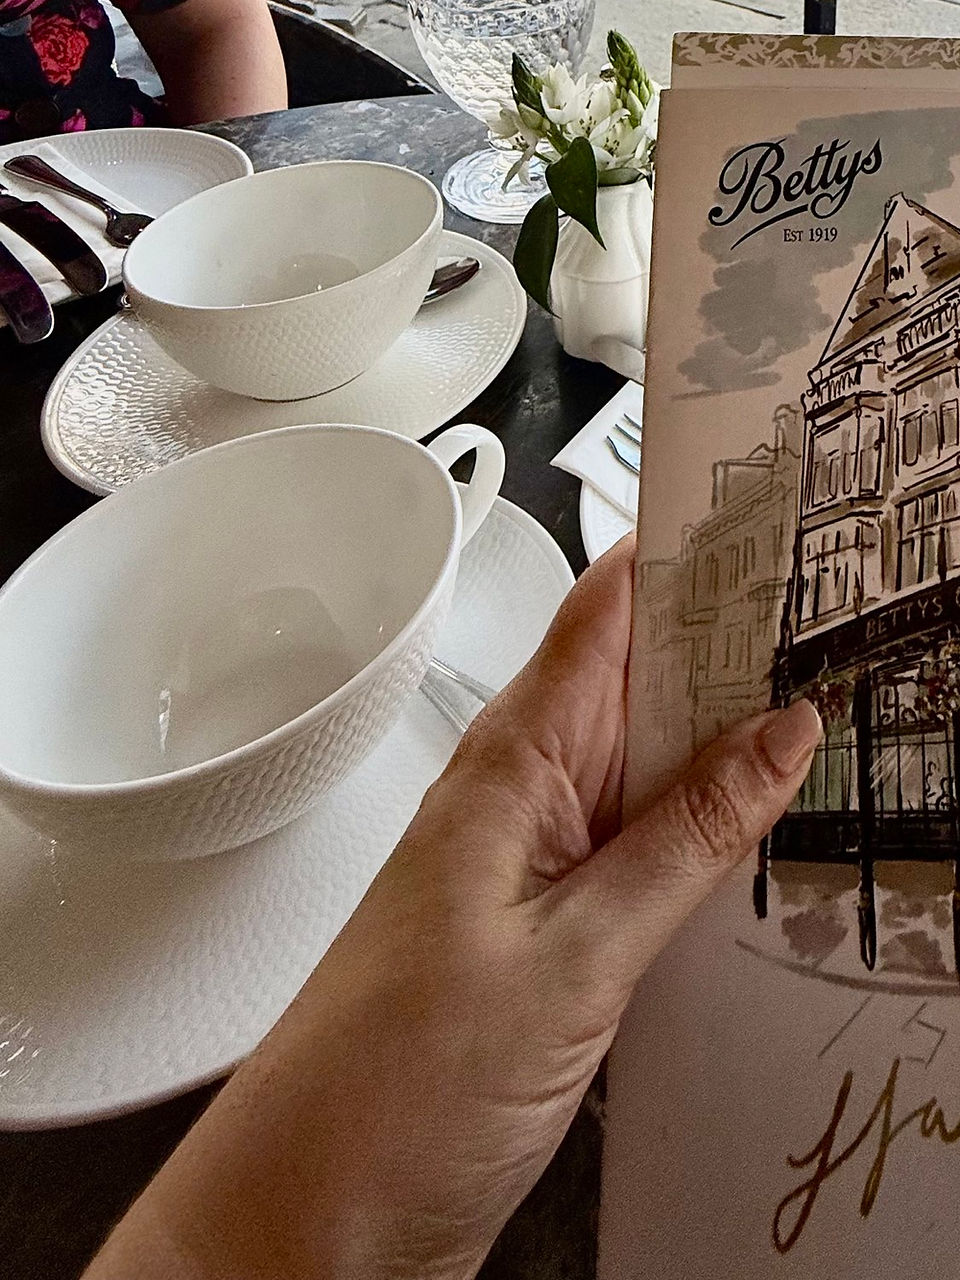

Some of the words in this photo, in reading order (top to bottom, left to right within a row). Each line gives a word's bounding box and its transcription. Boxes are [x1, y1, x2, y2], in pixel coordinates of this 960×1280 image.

[708, 138, 882, 227] Bettys
[808, 227, 838, 243] 1919
[864, 594, 945, 641] BETTYS
